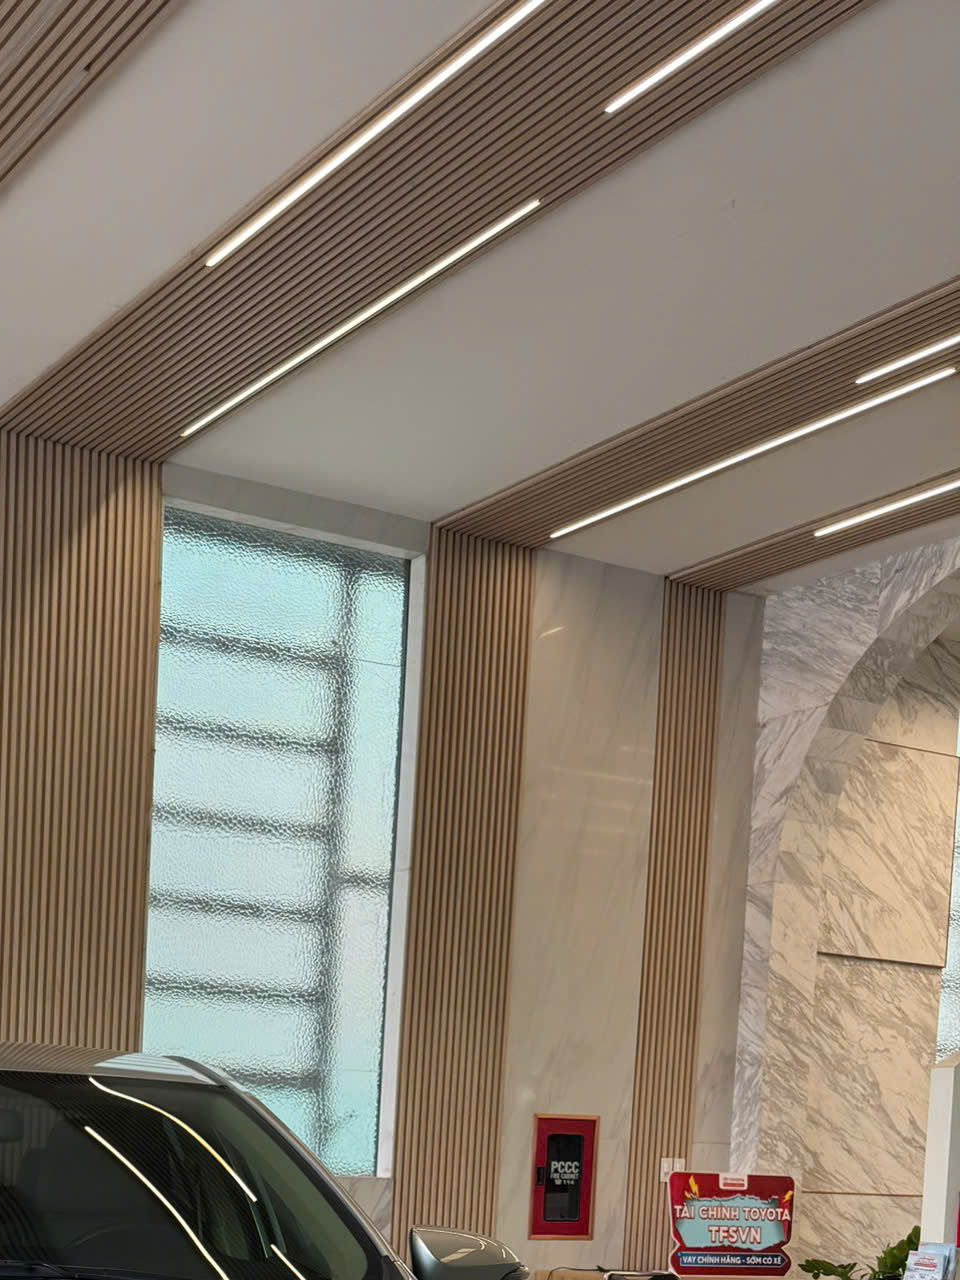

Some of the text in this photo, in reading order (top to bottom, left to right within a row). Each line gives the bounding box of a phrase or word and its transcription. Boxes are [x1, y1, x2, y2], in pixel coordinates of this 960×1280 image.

[551, 1161, 580, 1173] PCCC
[742, 1207, 791, 1221] TOYOTA
[708, 1225, 762, 1244] TFSVN
[682, 1255, 696, 1264] VAY
[697, 1254, 720, 1264] CHÍNH
